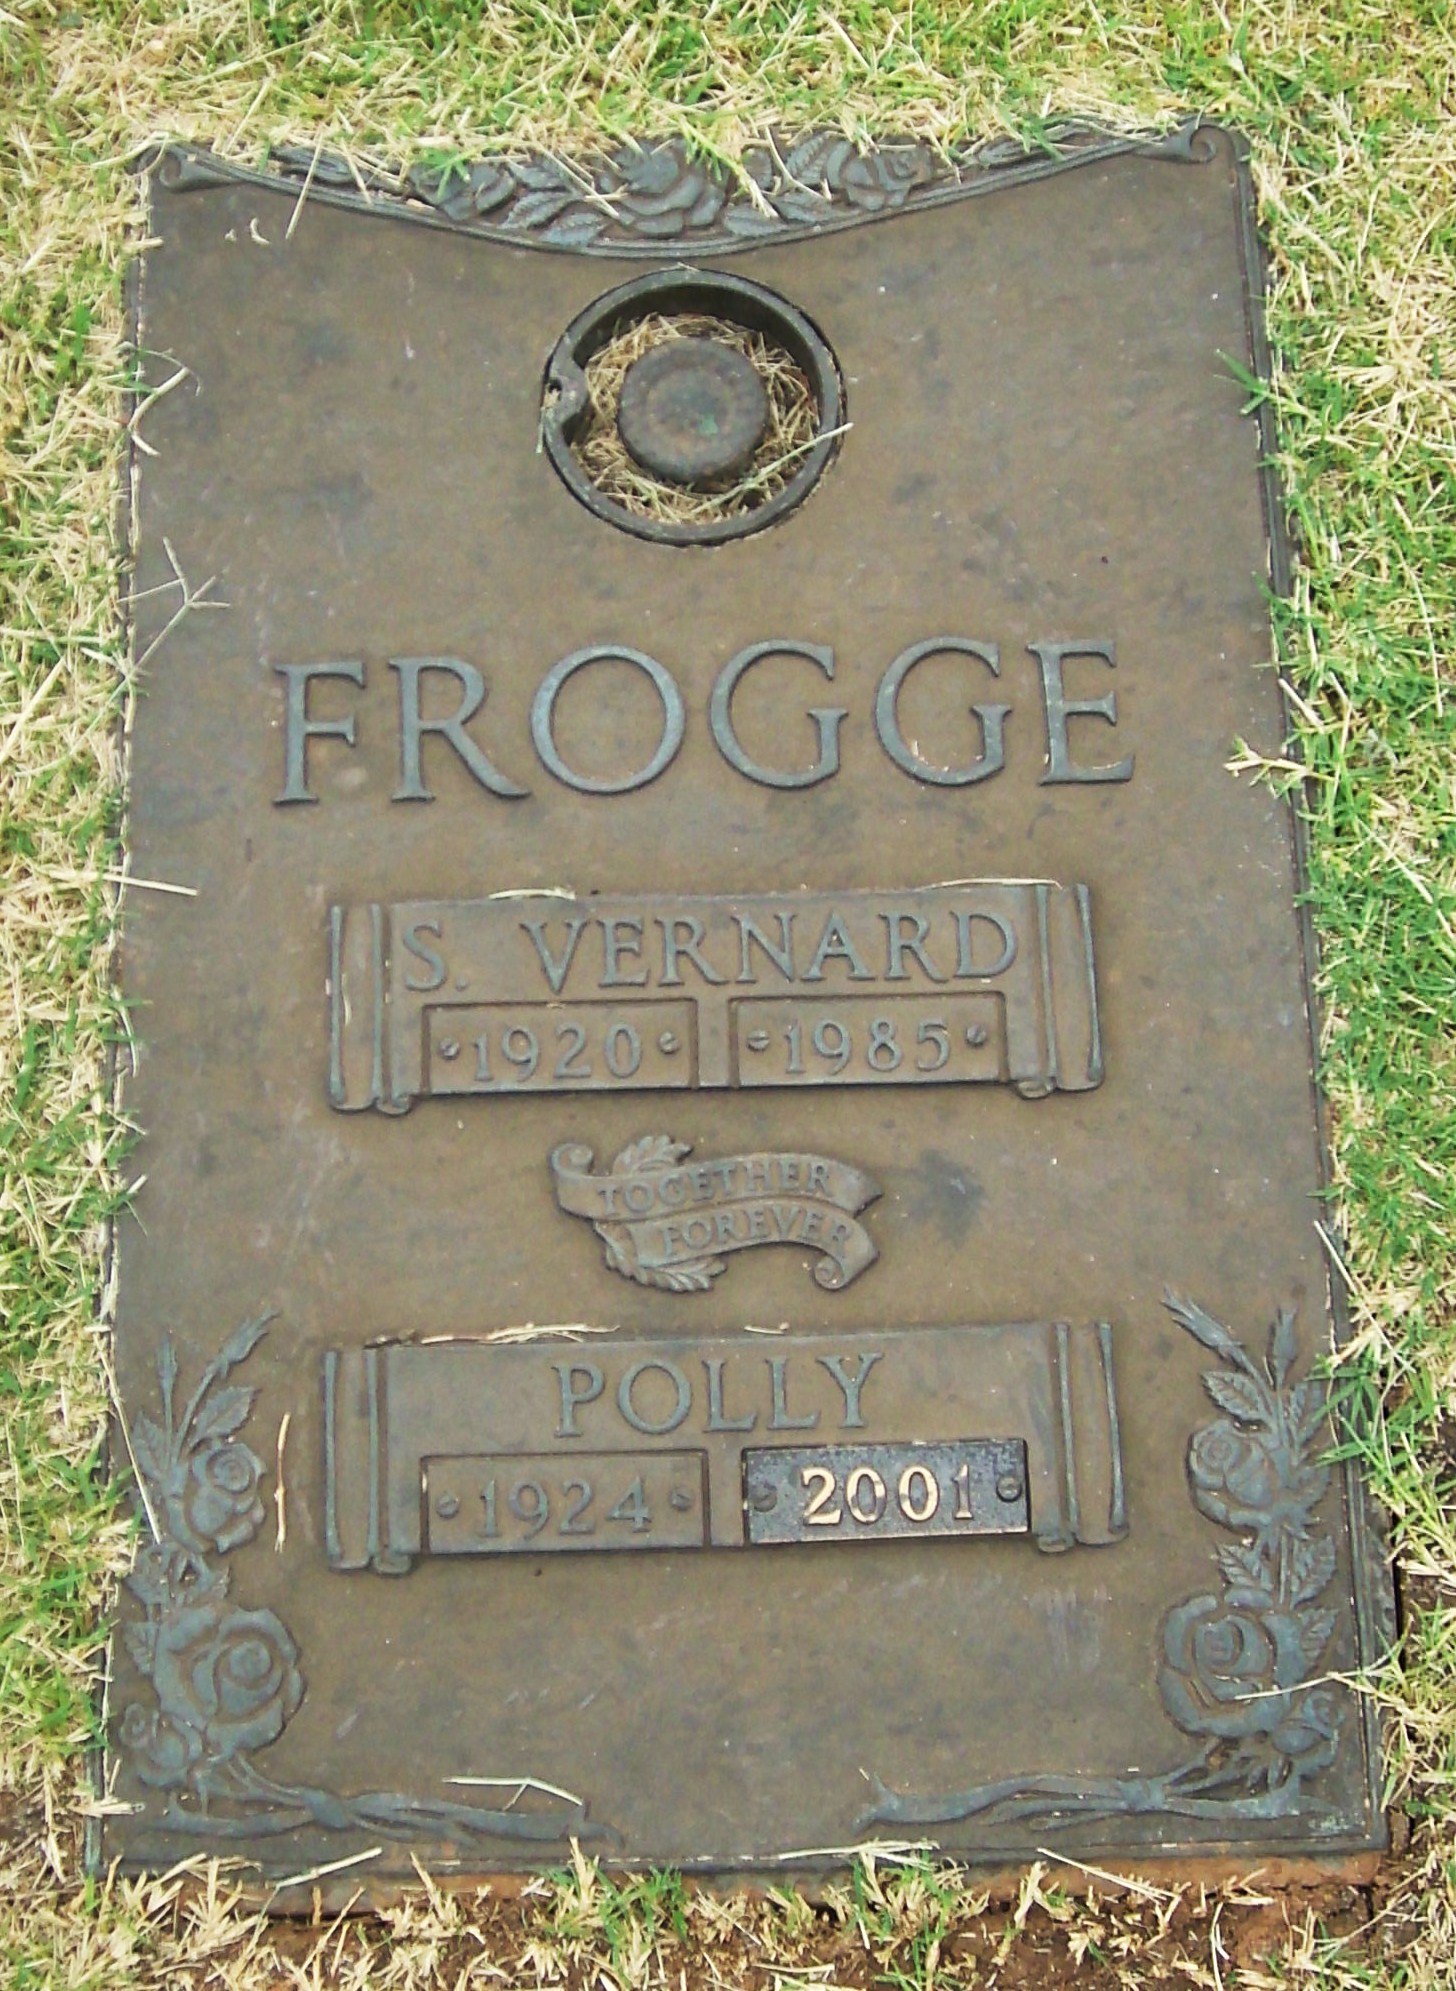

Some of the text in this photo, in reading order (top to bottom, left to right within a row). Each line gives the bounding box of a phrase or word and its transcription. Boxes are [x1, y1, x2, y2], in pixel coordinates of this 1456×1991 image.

[274, 637, 1135, 806] FROGGE
[402, 909, 1018, 993] S. VERNARD
[475, 1023, 642, 1081] 1920
[784, 1018, 951, 1074] 1985
[597, 1158, 834, 1217] TOGETHER
[660, 1204, 850, 1258] FOREVER
[550, 1350, 885, 1438] POLLY
[477, 1475, 653, 1540] 1924
[801, 1463, 973, 1526] 2001
